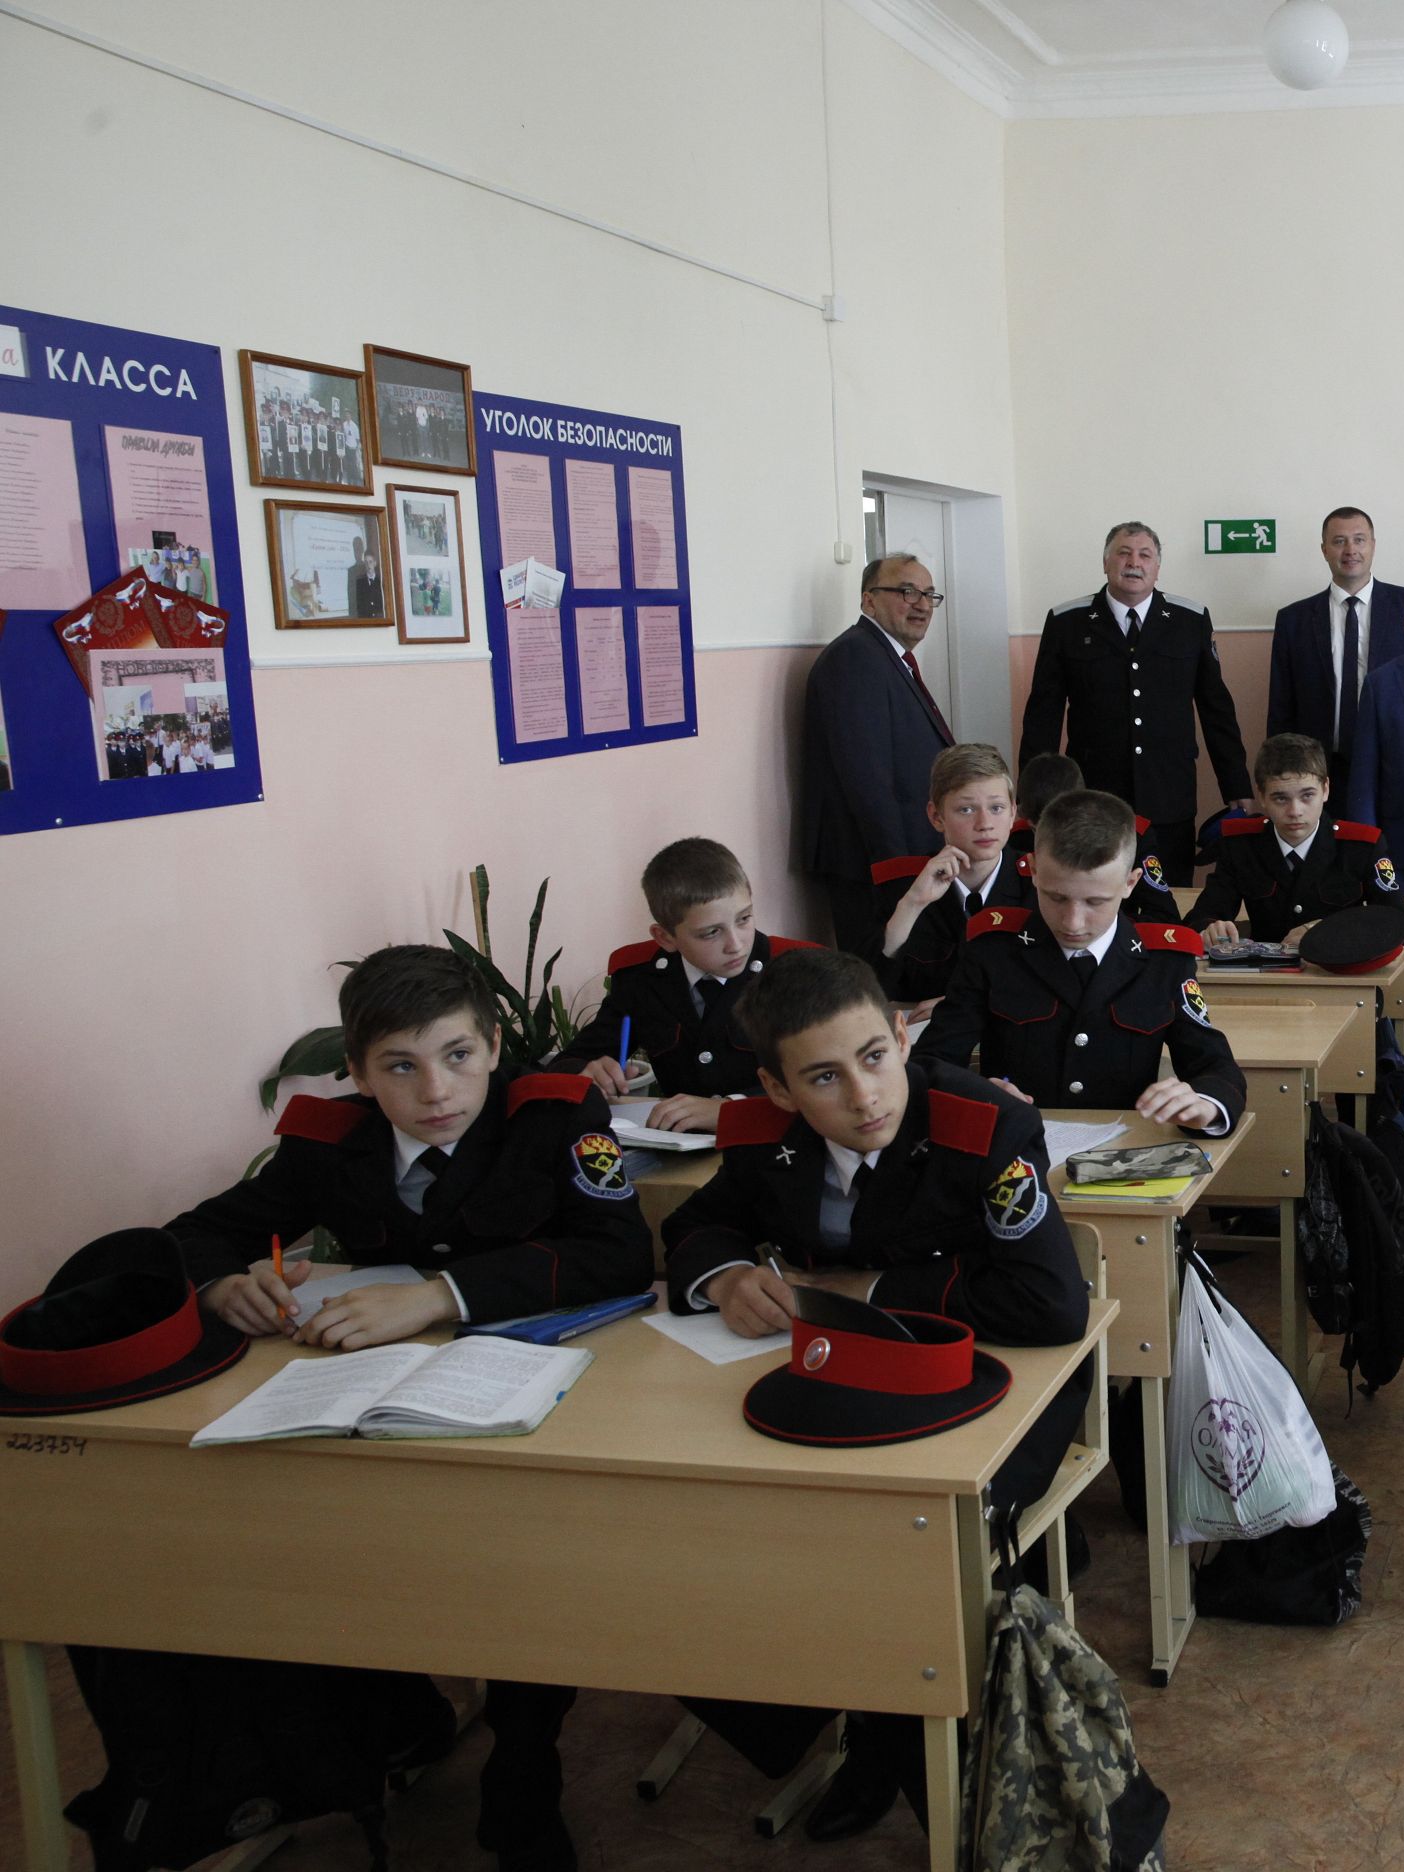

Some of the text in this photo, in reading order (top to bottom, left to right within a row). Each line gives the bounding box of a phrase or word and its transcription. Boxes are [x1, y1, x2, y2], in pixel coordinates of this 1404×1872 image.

[45, 346, 198, 401] КЛАССА
[480, 407, 554, 441] УГОЛОК
[557, 419, 673, 457] БЕЗОПАСНОСТИ
